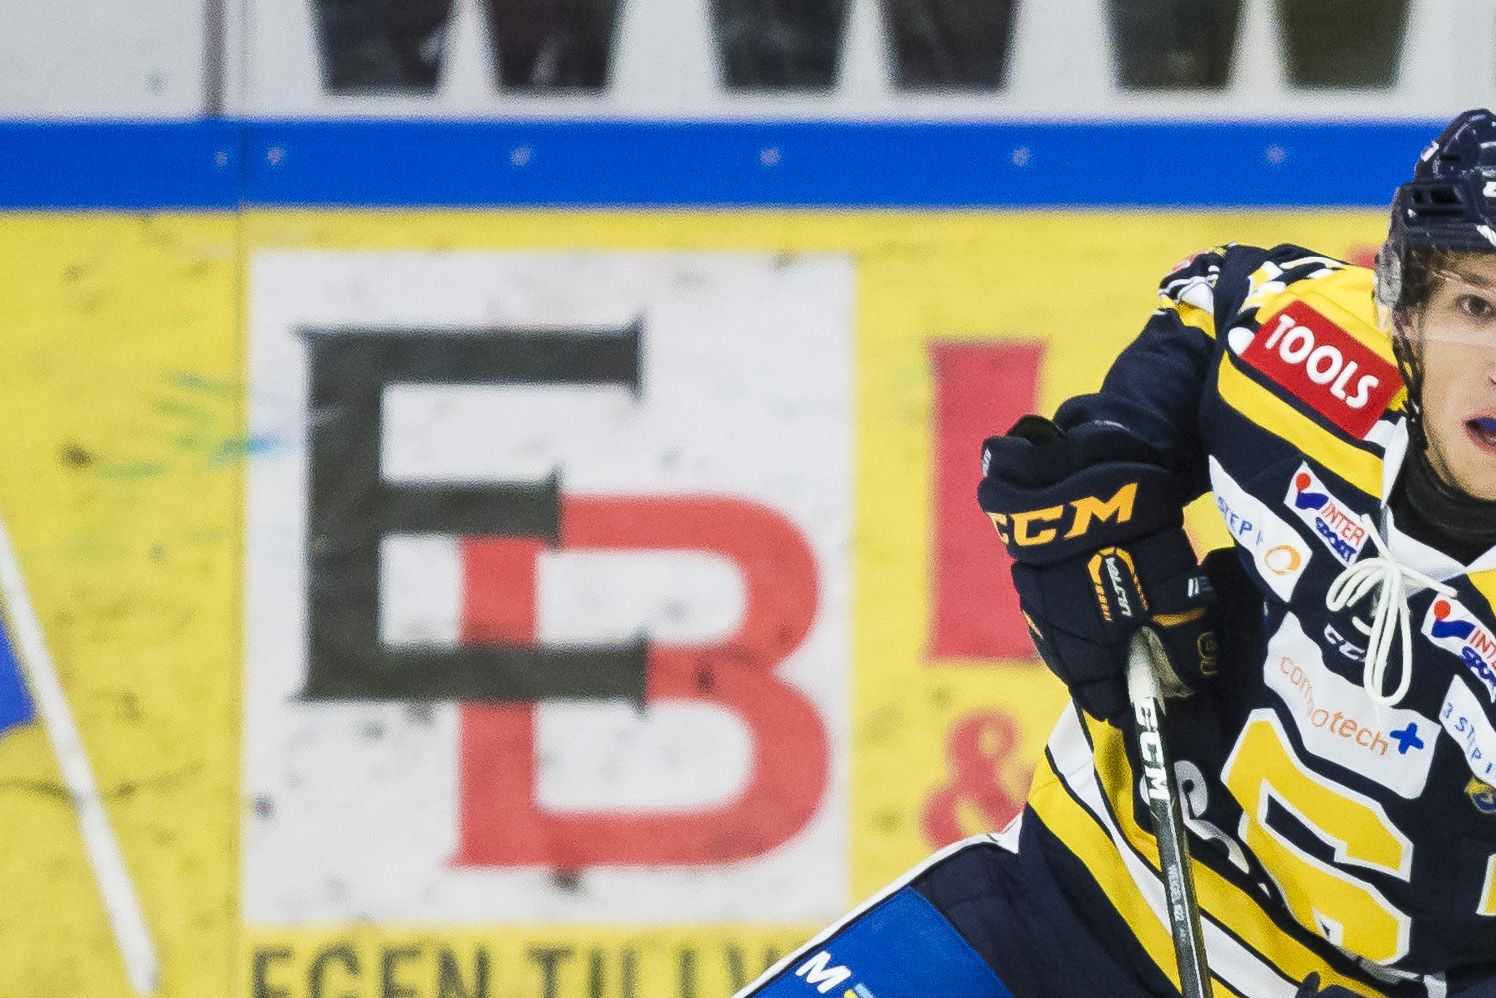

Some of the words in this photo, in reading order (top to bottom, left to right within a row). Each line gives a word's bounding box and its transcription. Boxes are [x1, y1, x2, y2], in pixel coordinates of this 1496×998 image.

[1264, 314, 1380, 409] TOOLS
[985, 482, 1138, 547] CCM
[1321, 501, 1366, 547] INTER
[1324, 623, 1366, 663] CC
[1134, 697, 1171, 801] CCM
